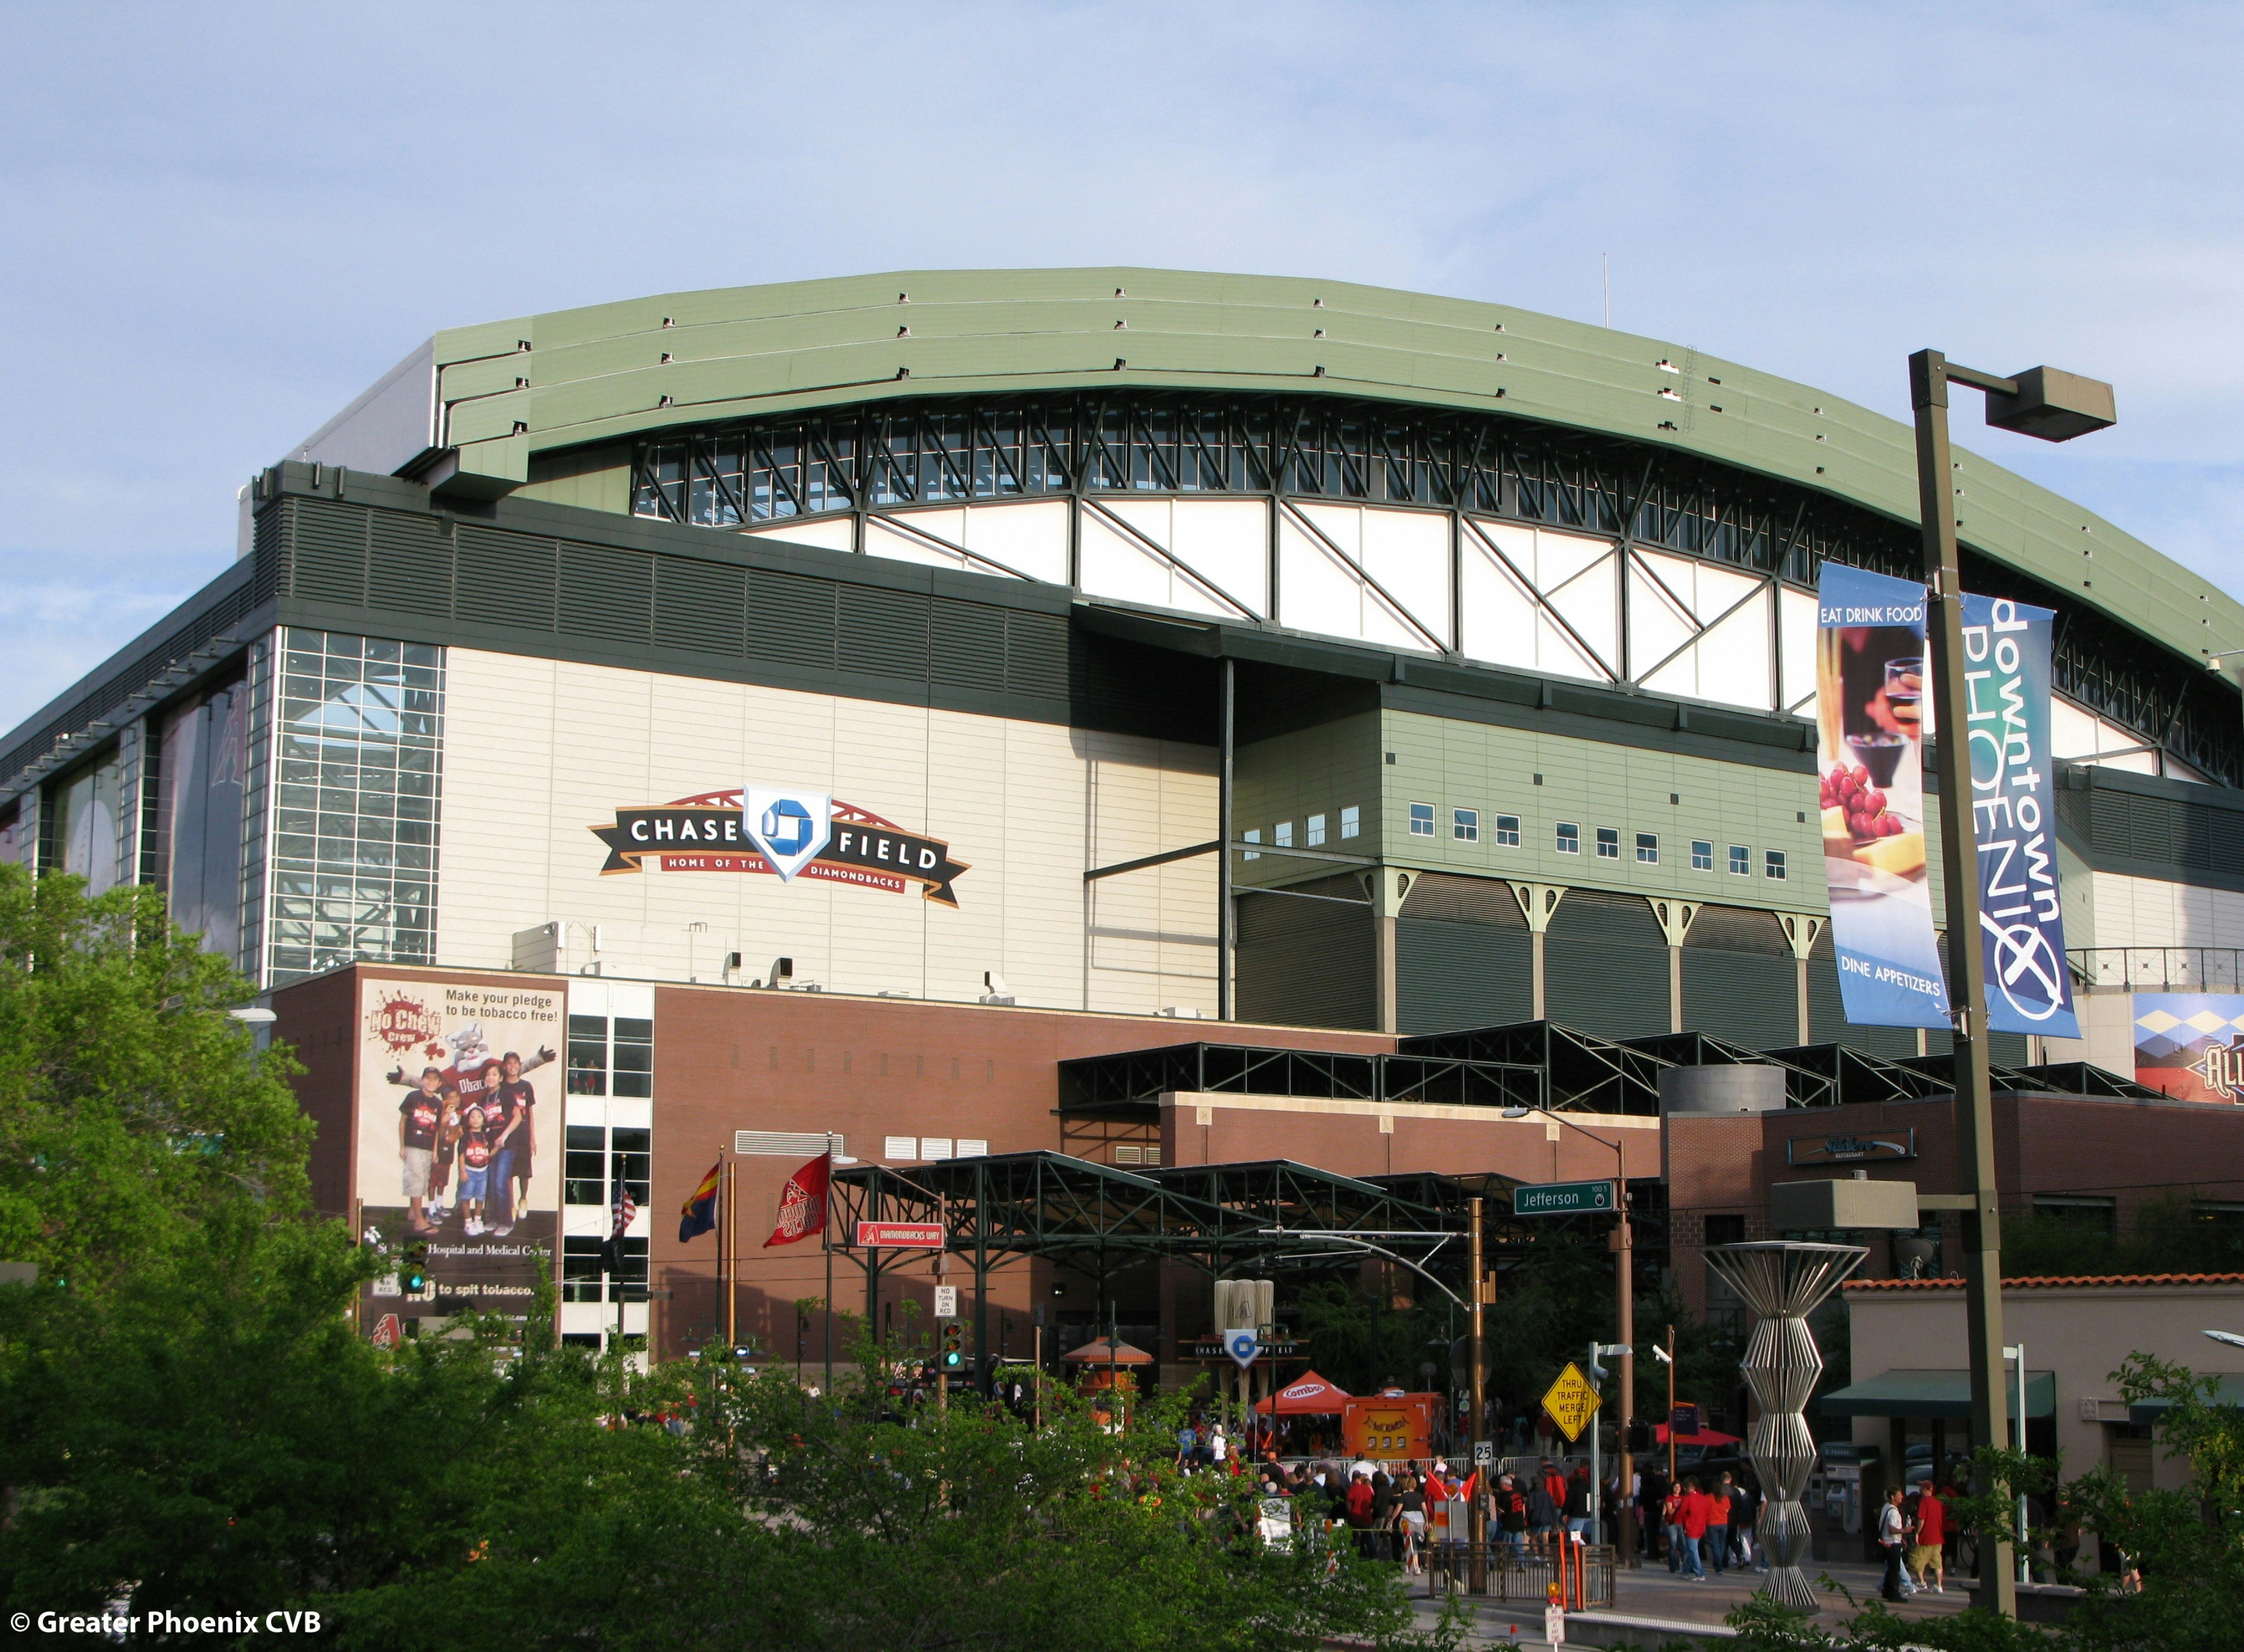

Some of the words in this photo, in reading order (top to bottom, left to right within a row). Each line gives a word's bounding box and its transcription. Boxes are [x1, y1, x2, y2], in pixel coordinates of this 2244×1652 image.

[1821, 608, 1842, 623] EAT
[1846, 607, 1883, 623] DRINK
[1886, 607, 1922, 622] FOOD
[1992, 598, 2059, 923] downtown
[1961, 625, 2064, 1021] PHOENIX
[631, 819, 738, 842] CHASE
[840, 832, 937, 870] FIELD
[669, 858, 707, 868] HOME
[715, 858, 731, 868] OF
[741, 860, 764, 870] THE
[810, 866, 901, 889] DIAMONDBACKS
[1841, 955, 1871, 978] DINE
[1874, 966, 1941, 997] APPETIZERS
[446, 989, 478, 1002] Make
[483, 992, 508, 1004] your
[513, 994, 552, 1009] pledge
[446, 1005, 457, 1016] to
[462, 1005, 476, 1017] be
[480, 1006, 527, 1020] tobacco
[531, 1010, 558, 1022] free!
[371, 1010, 392, 1032] No
[395, 1008, 441, 1035] Chew
[387, 1032, 416, 1042] Crew
[458, 1078, 487, 1094] Dbac
[1524, 1192, 1579, 1207] Jefferson
[880, 1230, 925, 1241] DIAMONDBACKS
[926, 1231, 940, 1240] WAY
[427, 1243, 465, 1258] Hospital
[467, 1244, 484, 1255] and
[485, 1244, 520, 1256] Medical
[438, 1283, 452, 1294] to
[455, 1283, 479, 1297] spit
[482, 1283, 535, 1296] tobacco.
[1286, 1385, 1323, 1397] Combos
[1562, 1379, 1582, 1388] THRU
[1557, 1391, 1587, 1400] TRAFFIC
[1559, 1403, 1586, 1412] MERGE
[1563, 1415, 1582, 1424] LEFT
[1476, 1447, 1491, 1459] 25
